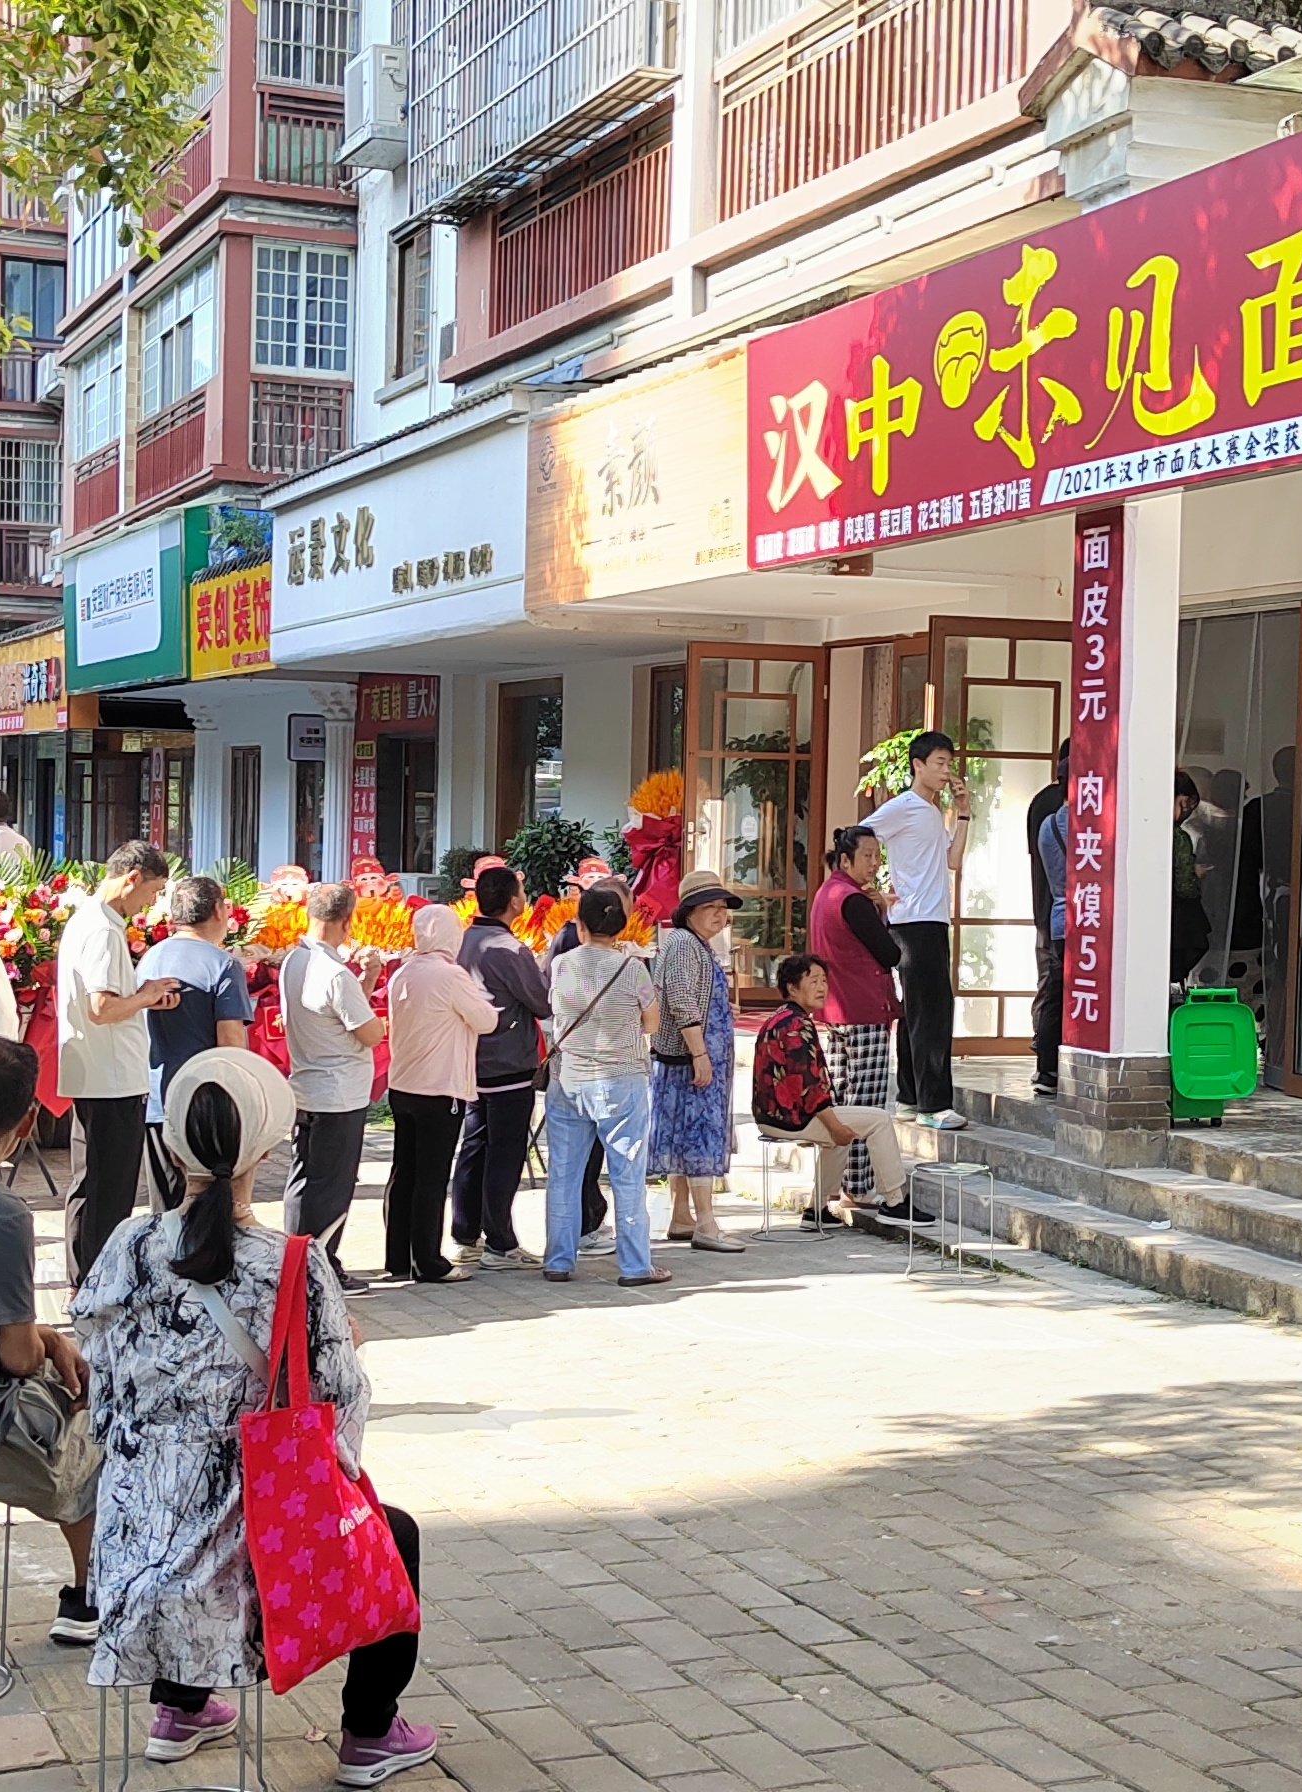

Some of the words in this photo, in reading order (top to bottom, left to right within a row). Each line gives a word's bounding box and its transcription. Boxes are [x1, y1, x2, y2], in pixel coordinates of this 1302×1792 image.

[844, 516, 875, 547] 肉夹馍
[879, 505, 913, 539] 菜豆腐
[917, 491, 964, 533] 花生稀饭
[968, 477, 1032, 521] 五香茶叶蛋
[196, 577, 272, 654] 荣创装饰
[1078, 527, 1111, 723] 面皮3元
[360, 684, 403, 722] 厂家直销
[1071, 770, 1104, 1023] 肉夹馍5元
